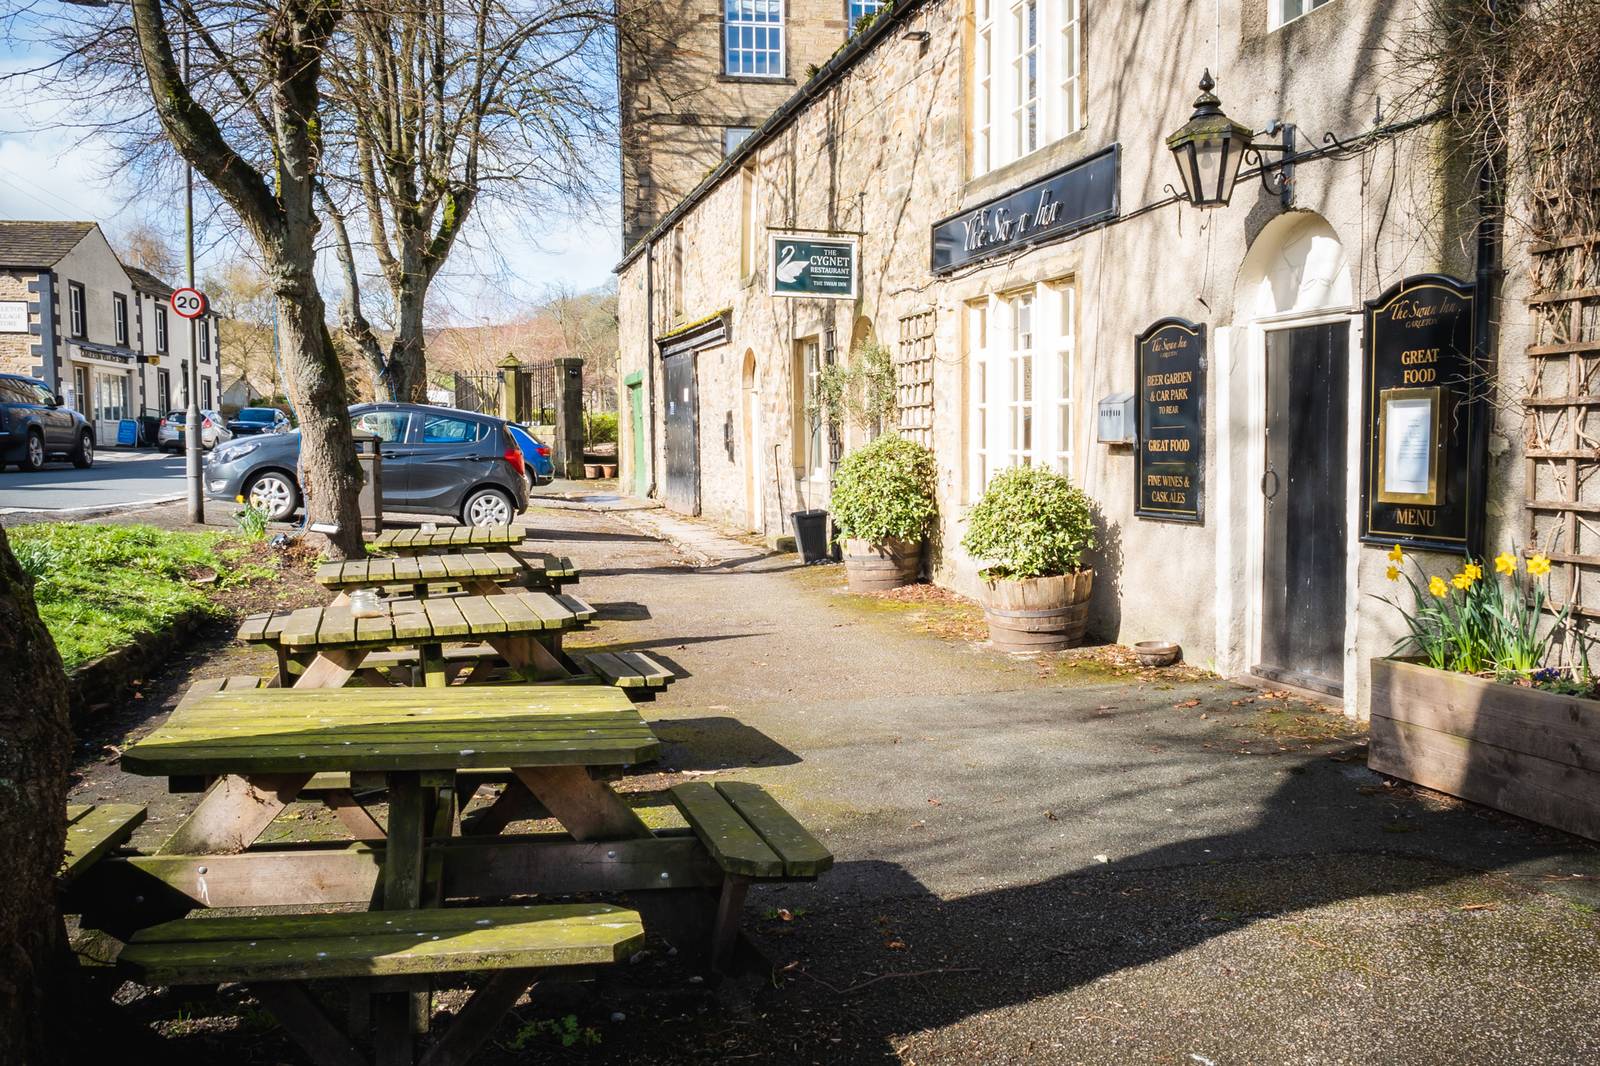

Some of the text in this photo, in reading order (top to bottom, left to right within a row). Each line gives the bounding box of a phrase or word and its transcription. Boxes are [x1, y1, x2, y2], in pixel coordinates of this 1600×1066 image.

[1032, 188, 1062, 228] Inn
[810, 255, 850, 267] CYGNET
[810, 266, 849, 275] RESTAURANT
[177, 296, 200, 310] 20
[1389, 295, 1457, 320] The Swan Inn
[1401, 348, 1439, 365] GREAT
[1147, 371, 1192, 386] BEER GARDEN
[1403, 368, 1436, 384] FOOD
[1150, 388, 1188, 402] & CAR PARK
[1158, 405, 1179, 414] TO REAR
[1148, 439, 1190, 452] GREAT FOOD
[1147, 475, 1190, 488] FINE WINES &
[1151, 491, 1185, 504] CASK ALES
[1395, 508, 1437, 527] MENU
